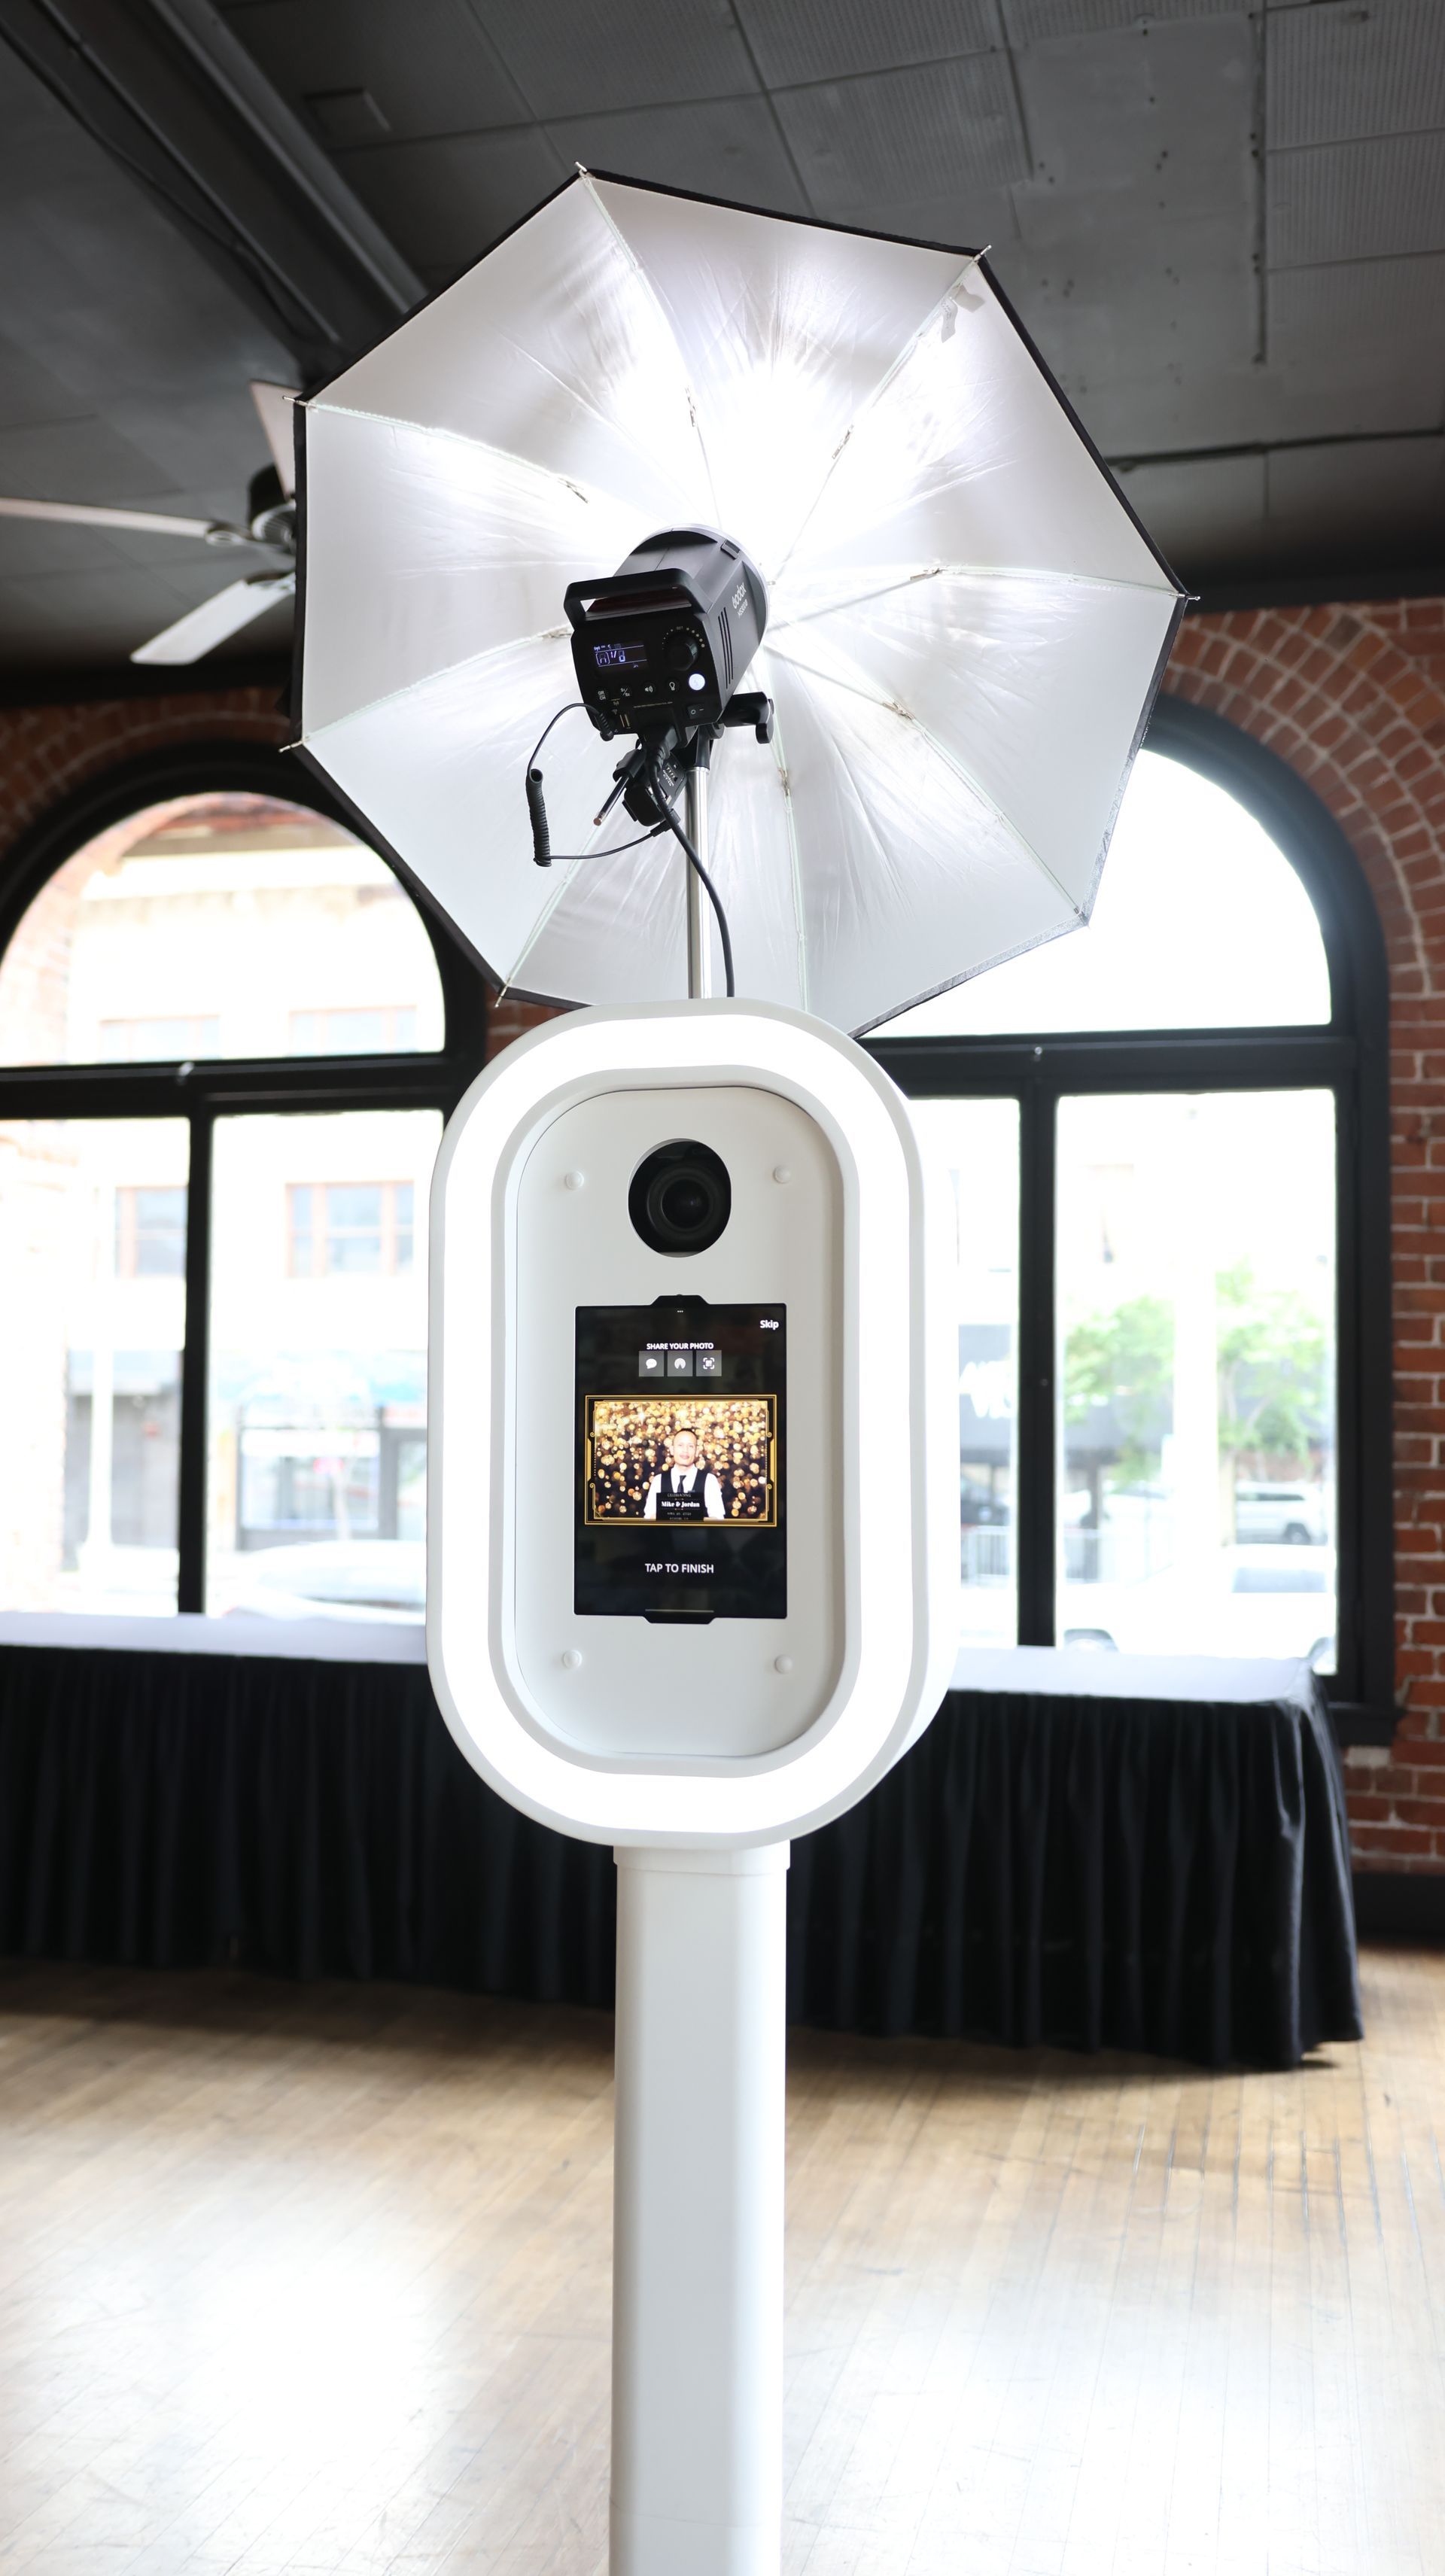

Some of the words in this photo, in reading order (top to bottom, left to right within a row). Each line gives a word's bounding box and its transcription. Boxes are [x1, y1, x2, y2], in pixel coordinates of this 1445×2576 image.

[759, 1319, 780, 1330] Skip
[644, 1563, 663, 1573] TAP
[665, 1563, 680, 1573] TO
[681, 1564, 714, 1574] FINISH
